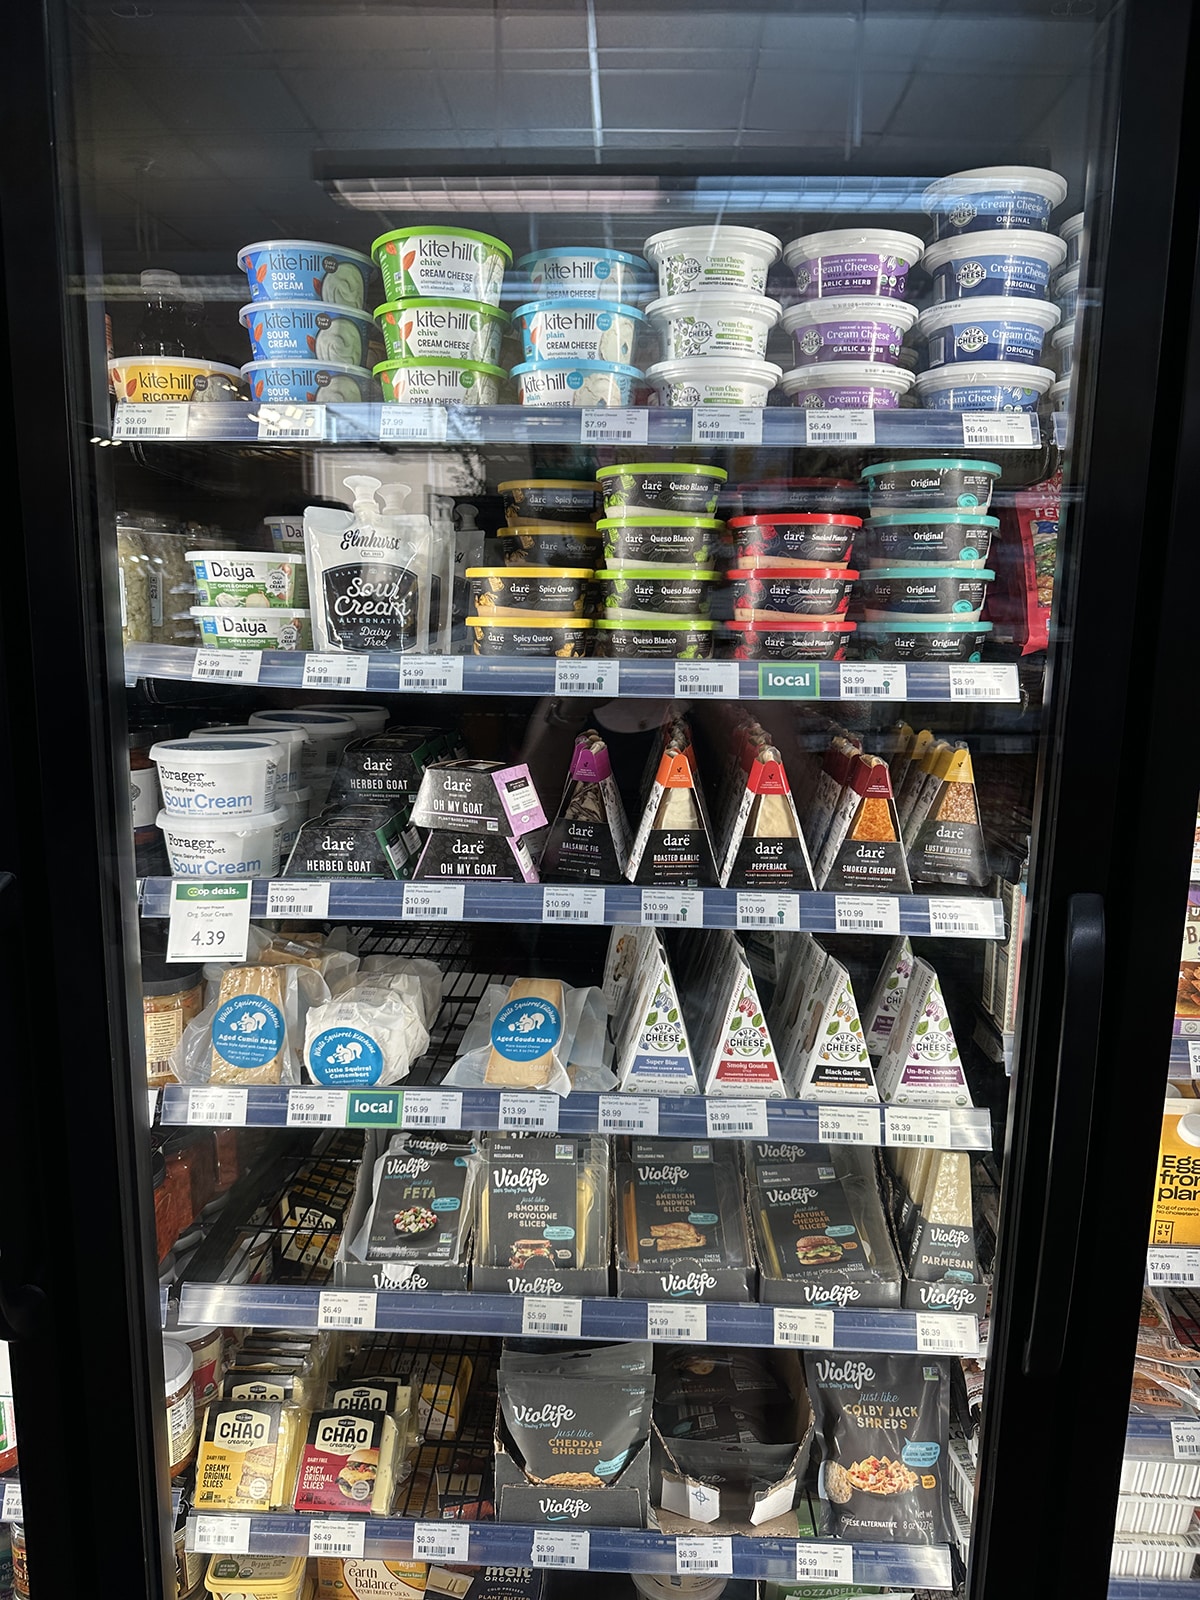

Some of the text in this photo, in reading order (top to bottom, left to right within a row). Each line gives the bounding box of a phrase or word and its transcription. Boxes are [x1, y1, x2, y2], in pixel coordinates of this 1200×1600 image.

[996, 216, 1030, 224] ORIGINAL
[271, 273, 296, 281] SOUR
[420, 269, 473, 282] CREAM CHEESE
[272, 281, 303, 290] CREAM
[267, 331, 289, 339] SOUR
[546, 331, 565, 340] plain
[268, 340, 297, 348] CREAM
[418, 339, 470, 350] CREAM CHEESE
[547, 342, 597, 350] CREAM CHEESE
[958, 336, 988, 346] CHEESE
[1006, 346, 1034, 356] ORIGINAL
[125, 417, 146, 425] $9.69
[585, 420, 607, 428] $7.99
[965, 425, 988, 433] $6.49
[669, 483, 708, 493] Queso Blanco
[911, 478, 941, 489] Original
[340, 530, 400, 551] Elmhurst
[650, 535, 694, 544] Queso Blanco
[913, 531, 944, 542] Original
[210, 562, 255, 580] Daiya
[347, 577, 400, 598] Sour
[539, 585, 574, 594] Spicy Queso
[906, 584, 936, 595] Original
[334, 597, 411, 617] Cream
[222, 618, 268, 636] Daiya
[360, 626, 392, 639] Dairy
[364, 637, 388, 647] Free
[513, 634, 553, 643] Spicy Queso
[632, 637, 653, 646] Queso
[932, 638, 960, 649] Original
[306, 666, 328, 674] $4.99
[402, 668, 424, 677] $4.99
[768, 672, 810, 687] local
[842, 676, 864, 684] $8.99
[952, 677, 975, 686] $8.99
[160, 766, 205, 783] Forager
[351, 779, 408, 790] HERBED GOAT
[164, 791, 252, 809] Sour Cream
[434, 801, 483, 814] OH MY GOAT
[168, 833, 215, 850] Forager
[562, 842, 590, 850] BALSAMIC
[654, 854, 700, 862] ROASTED GARLIC
[306, 860, 371, 872] HERBED GOAT
[440, 863, 497, 875] OH MY GOAT
[752, 863, 787, 871] PEPPERJACK
[842, 864, 896, 875] SMOKED CHEDDAR
[740, 906, 764, 914] $10.99
[837, 909, 863, 917] $10.99
[932, 912, 958, 920] $10.99
[191, 931, 225, 946] 4.39
[646, 1034, 679, 1042] CHEESE
[730, 1038, 765, 1048] CHEESE
[826, 1043, 861, 1053] CHEESE
[916, 1042, 951, 1053] CHEESE
[727, 1062, 768, 1070] Smoky Gouda
[290, 1103, 315, 1111] $16.99
[355, 1100, 393, 1113] local
[710, 1113, 730, 1121] $8.99
[890, 1123, 911, 1131] $8.39
[387, 1158, 430, 1178] Violife
[638, 1165, 688, 1184] Violife
[493, 1167, 549, 1193] Violife
[403, 1187, 436, 1199] FETA
[766, 1187, 818, 1204] Violife
[508, 1212, 557, 1220] PROVOLONE
[792, 1217, 830, 1225] CHEDDAR
[931, 1229, 970, 1248] Violife
[922, 1255, 973, 1269] PARMESAN
[1151, 1262, 1170, 1270] $7.69
[661, 1272, 717, 1296] Violife
[804, 1285, 861, 1308] Violife
[920, 1287, 976, 1311] Violife
[323, 1306, 342, 1314] $6.49
[778, 1322, 797, 1330] $5.99
[816, 1360, 875, 1390] Violife
[513, 1404, 576, 1428] Violife
[843, 1405, 918, 1417] COLBY JACK
[857, 1417, 908, 1429] SHREDS
[220, 1423, 264, 1438] CHAO
[322, 1427, 367, 1443] CHAO
[549, 1439, 602, 1448] CHEDDAR
[1175, 1434, 1195, 1443] $4.99
[552, 1447, 599, 1455] SHREDS
[205, 1464, 230, 1472] CREAMY
[204, 1472, 232, 1480] ORIGINAL
[304, 1474, 333, 1482] ORIGINAL
[203, 1480, 223, 1488] SLICES
[303, 1482, 324, 1490] SLICES
[539, 1499, 591, 1518] Violife
[313, 1533, 331, 1541] $6.49
[536, 1545, 555, 1553] $6.99
[798, 1558, 817, 1566] $6.99
[349, 1567, 377, 1581] earth
[486, 1567, 532, 1578] melt
[354, 1577, 398, 1591] balance
[485, 1576, 531, 1584] ORGANIC
[793, 1587, 863, 1596] MOZZARELLA
